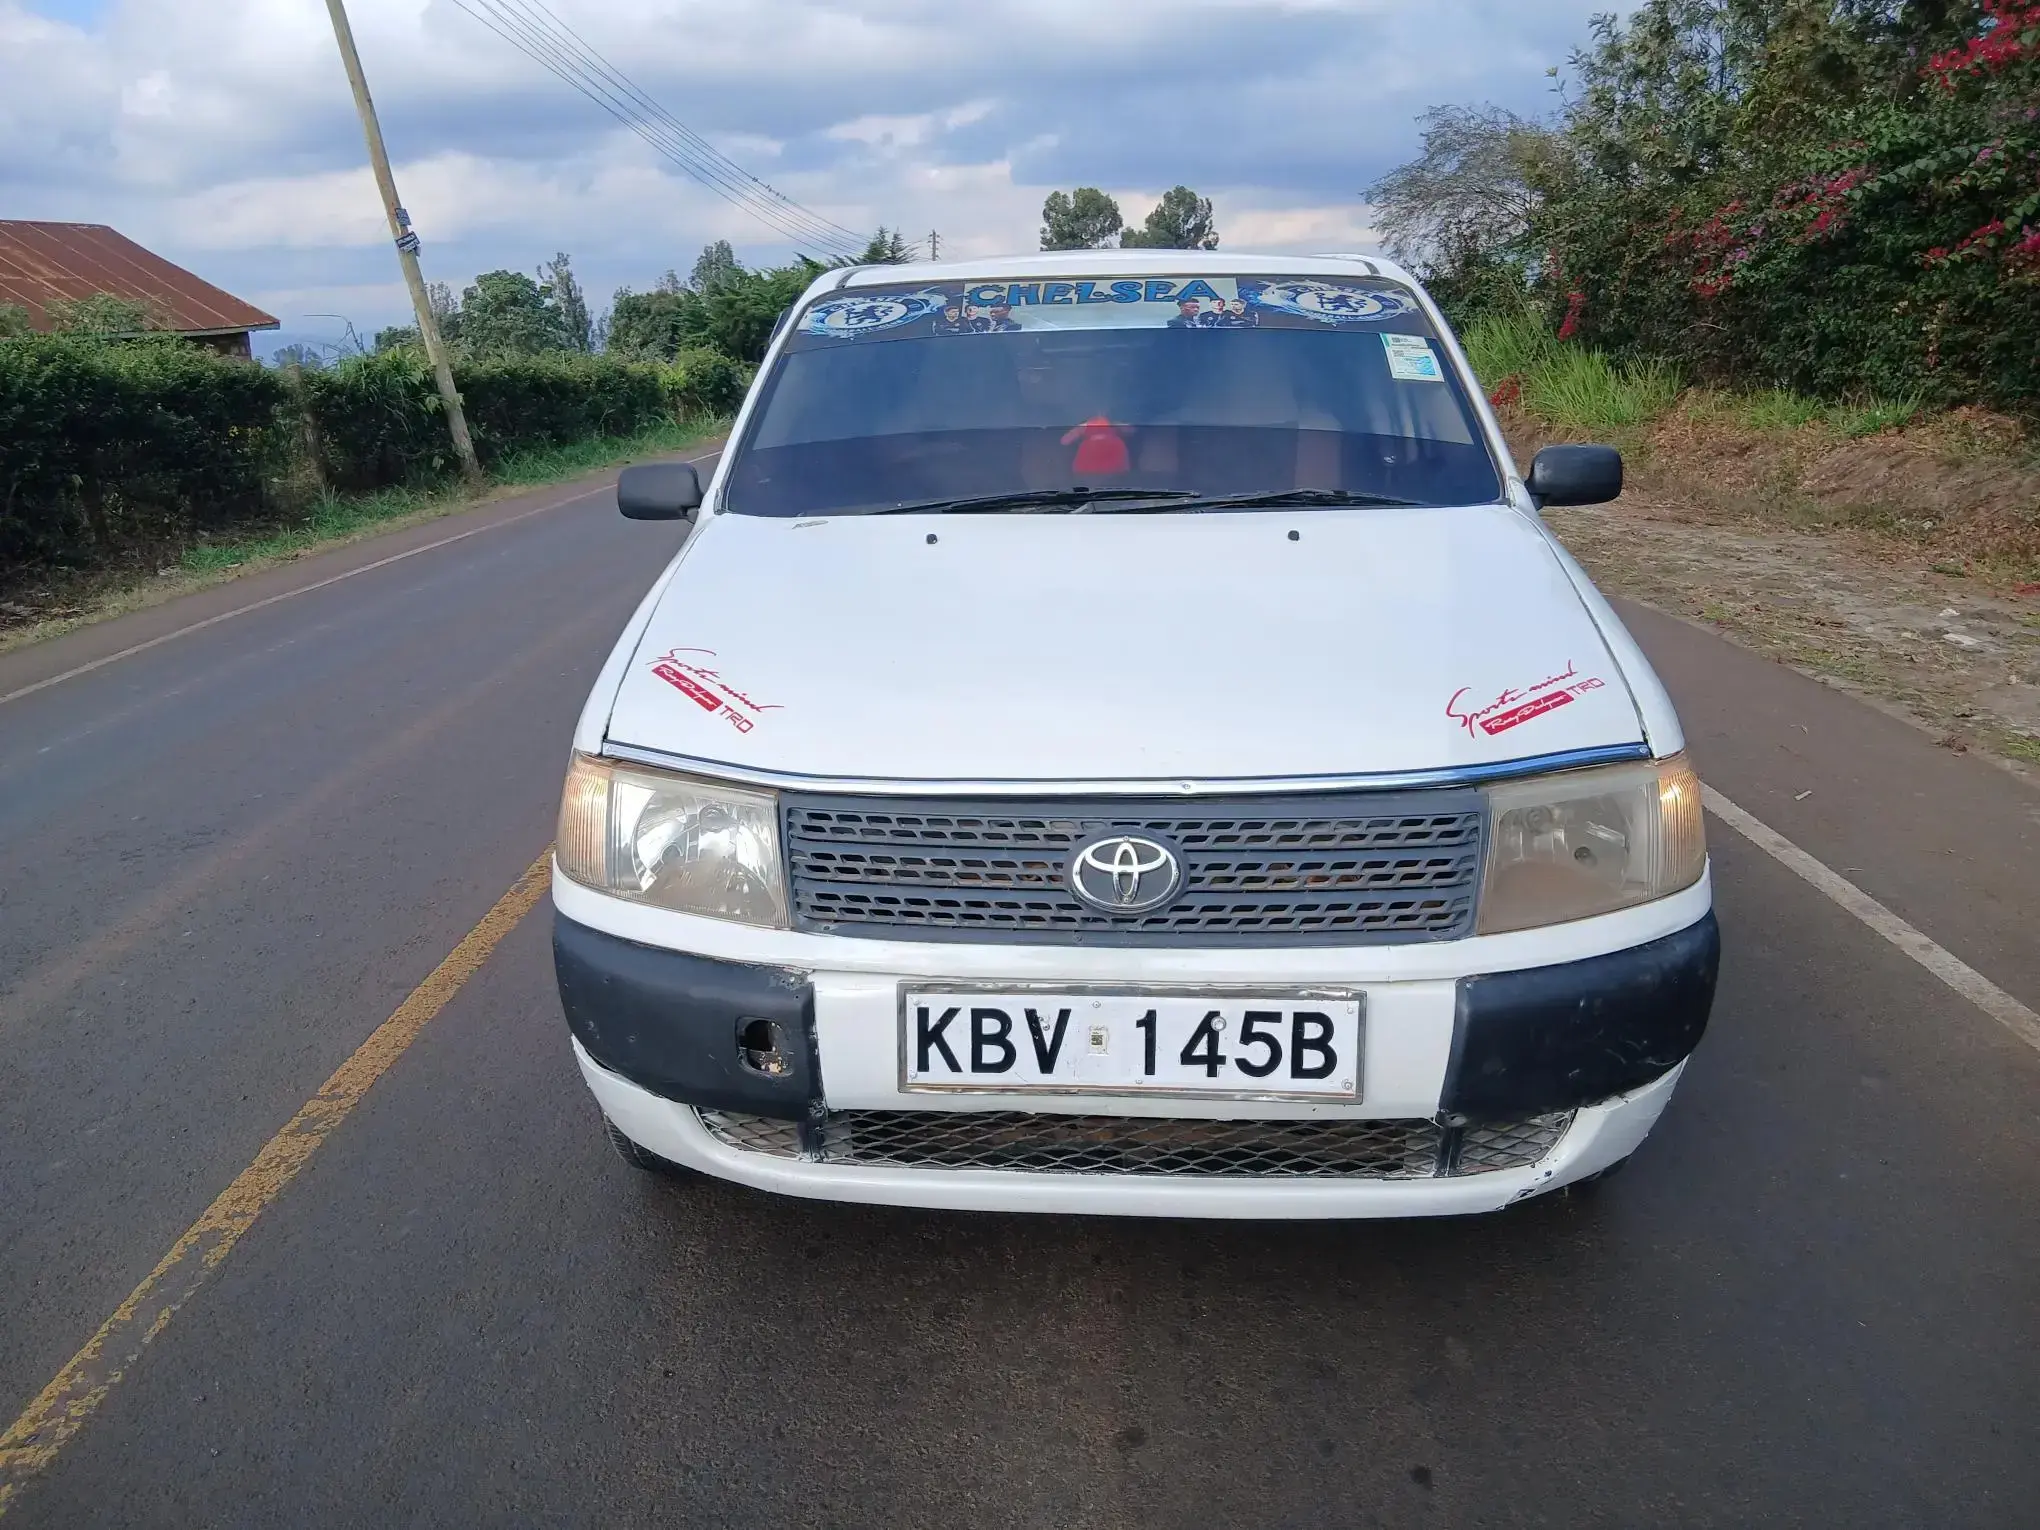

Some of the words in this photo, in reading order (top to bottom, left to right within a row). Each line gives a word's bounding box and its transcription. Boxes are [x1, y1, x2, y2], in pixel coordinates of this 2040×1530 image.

[967, 280, 1220, 307] CHELSEA
[1565, 677, 1606, 695] TRD
[720, 704, 754, 734] TRD
[916, 1006, 1072, 1075] KBV
[1135, 1008, 1338, 1080] 145B
